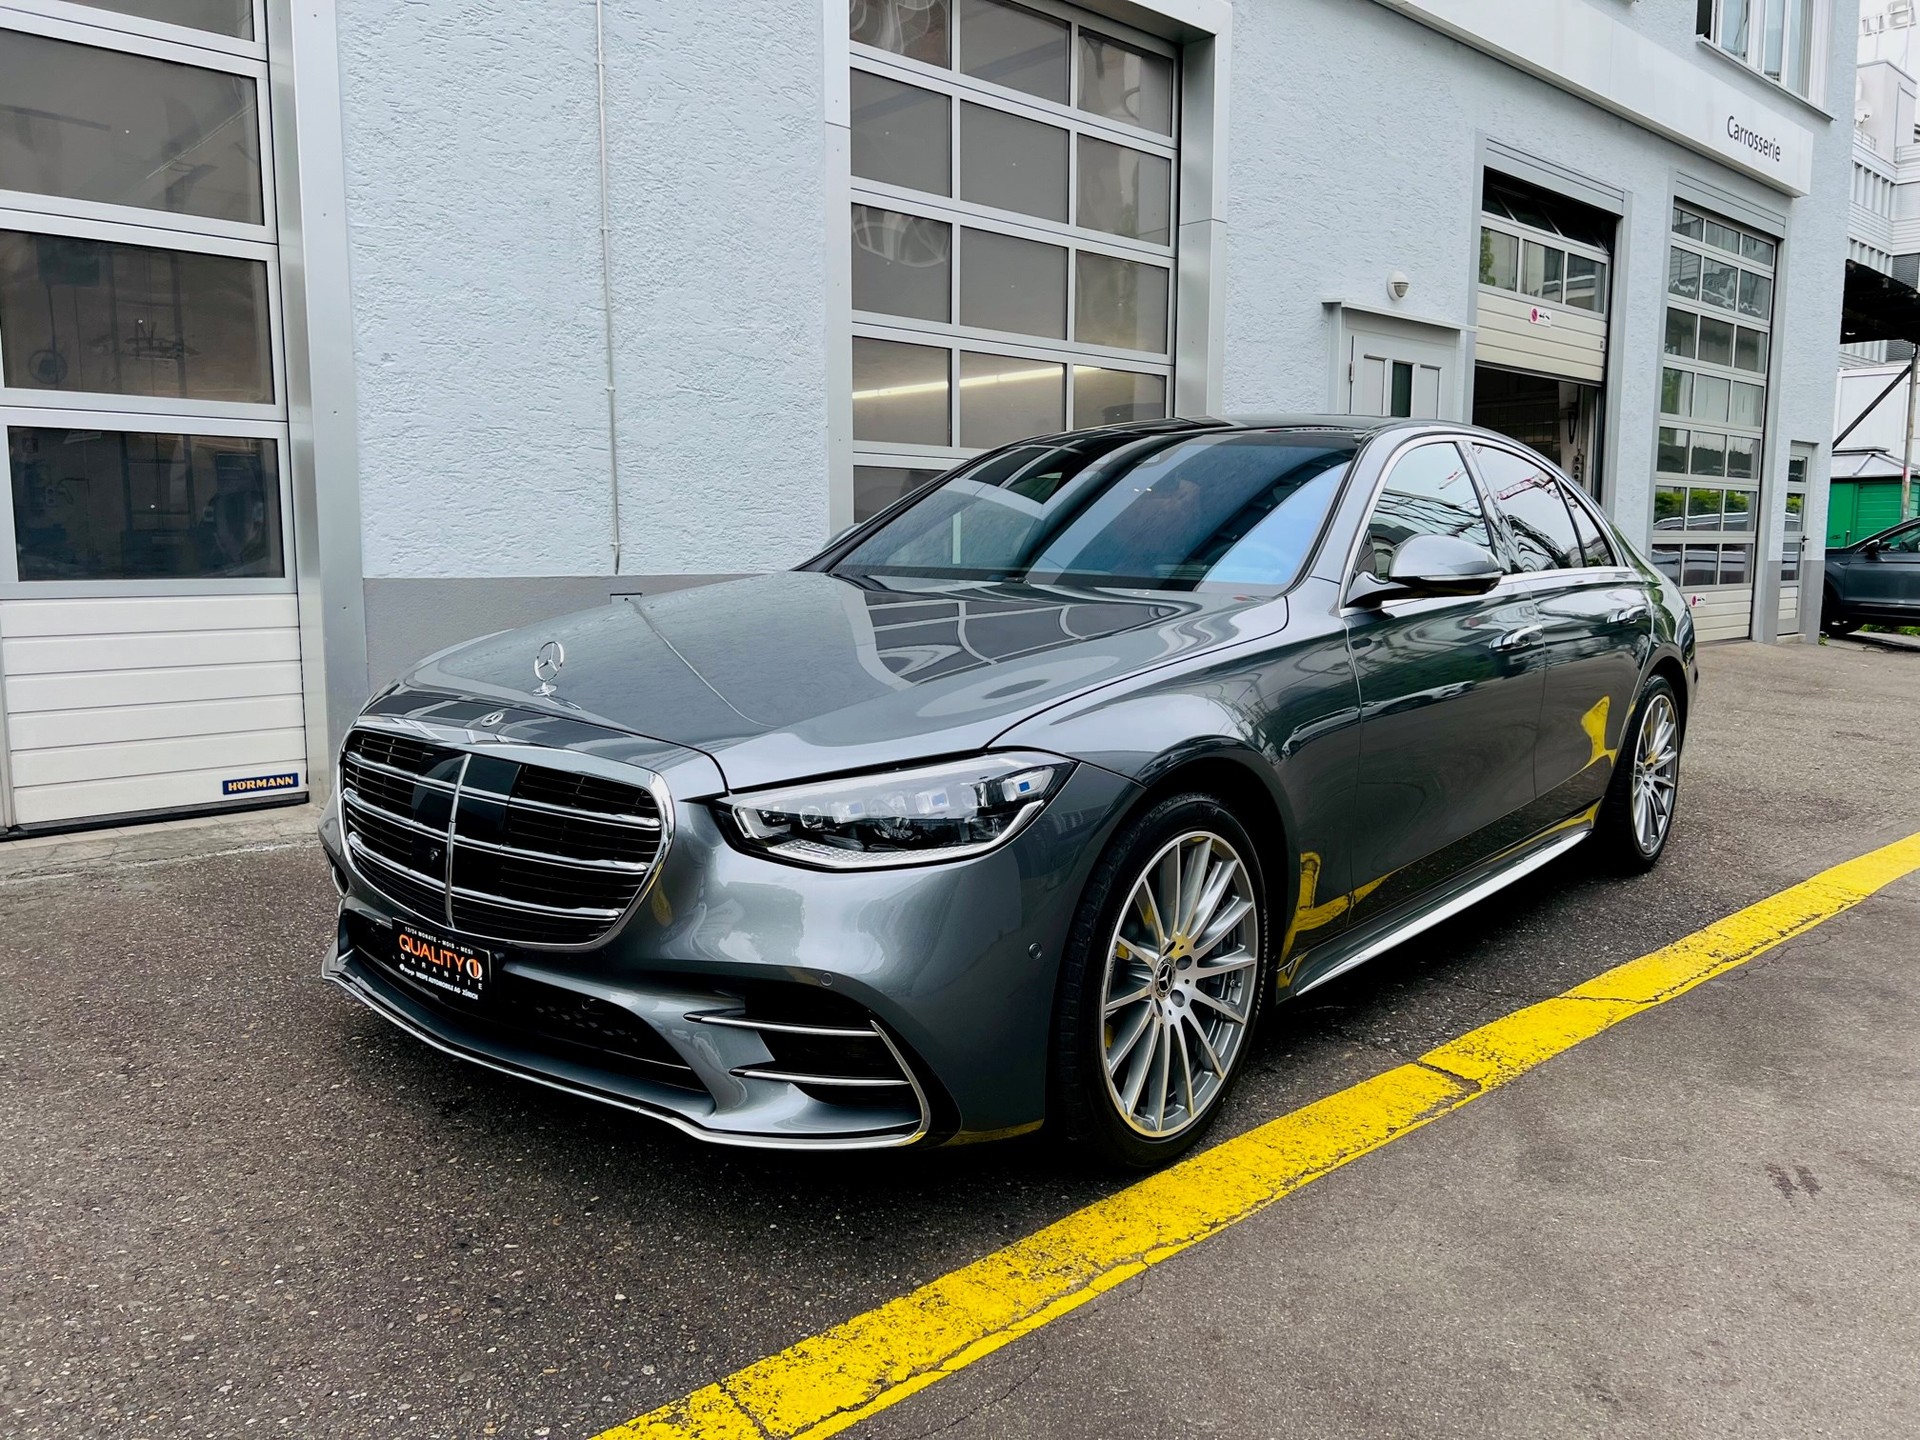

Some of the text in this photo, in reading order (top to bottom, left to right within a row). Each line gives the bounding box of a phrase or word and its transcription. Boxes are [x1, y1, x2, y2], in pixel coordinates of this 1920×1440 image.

[1727, 115, 1781, 162] Carrosserie
[399, 934, 465, 972] QUALITY
[400, 953, 483, 990] GARANTIE
